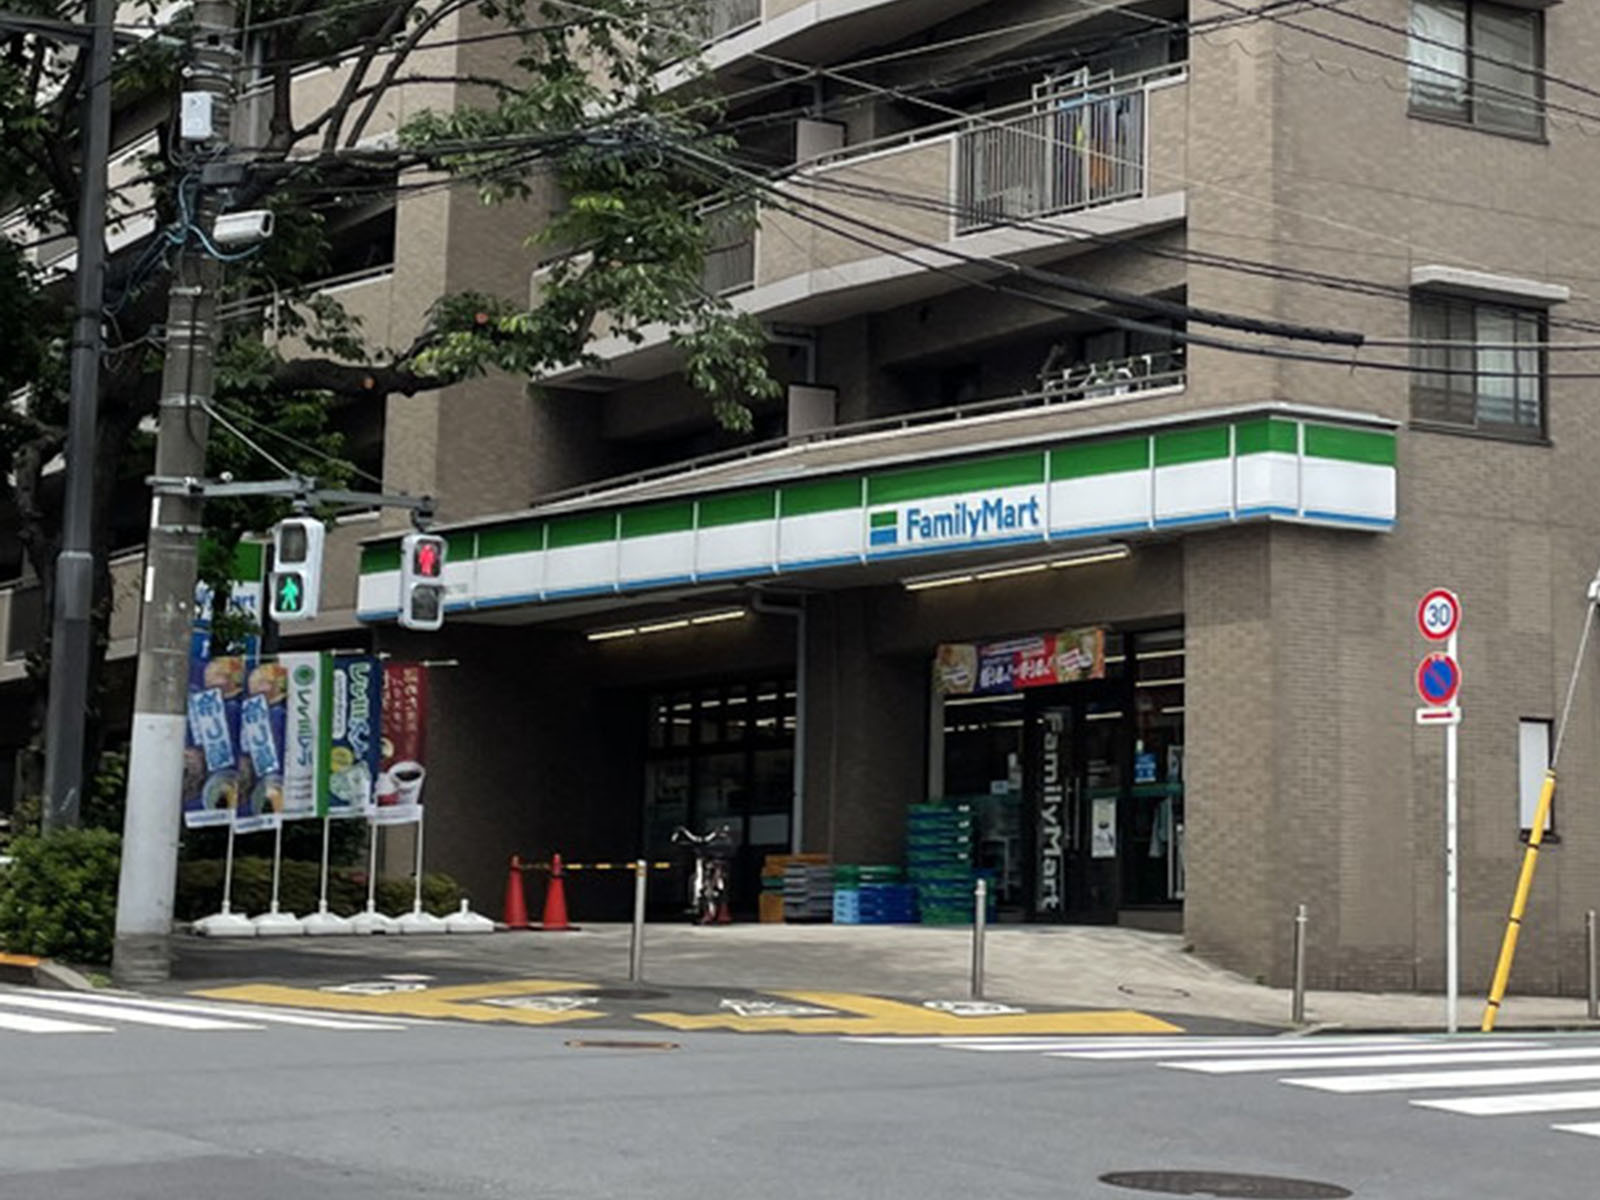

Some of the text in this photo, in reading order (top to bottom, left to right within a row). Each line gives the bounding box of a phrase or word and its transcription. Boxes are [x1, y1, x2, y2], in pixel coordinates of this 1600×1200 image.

[906, 495, 1039, 541] FamilyMart
[1427, 603, 1451, 627] 30
[1041, 711, 1064, 909] FamilyMart
